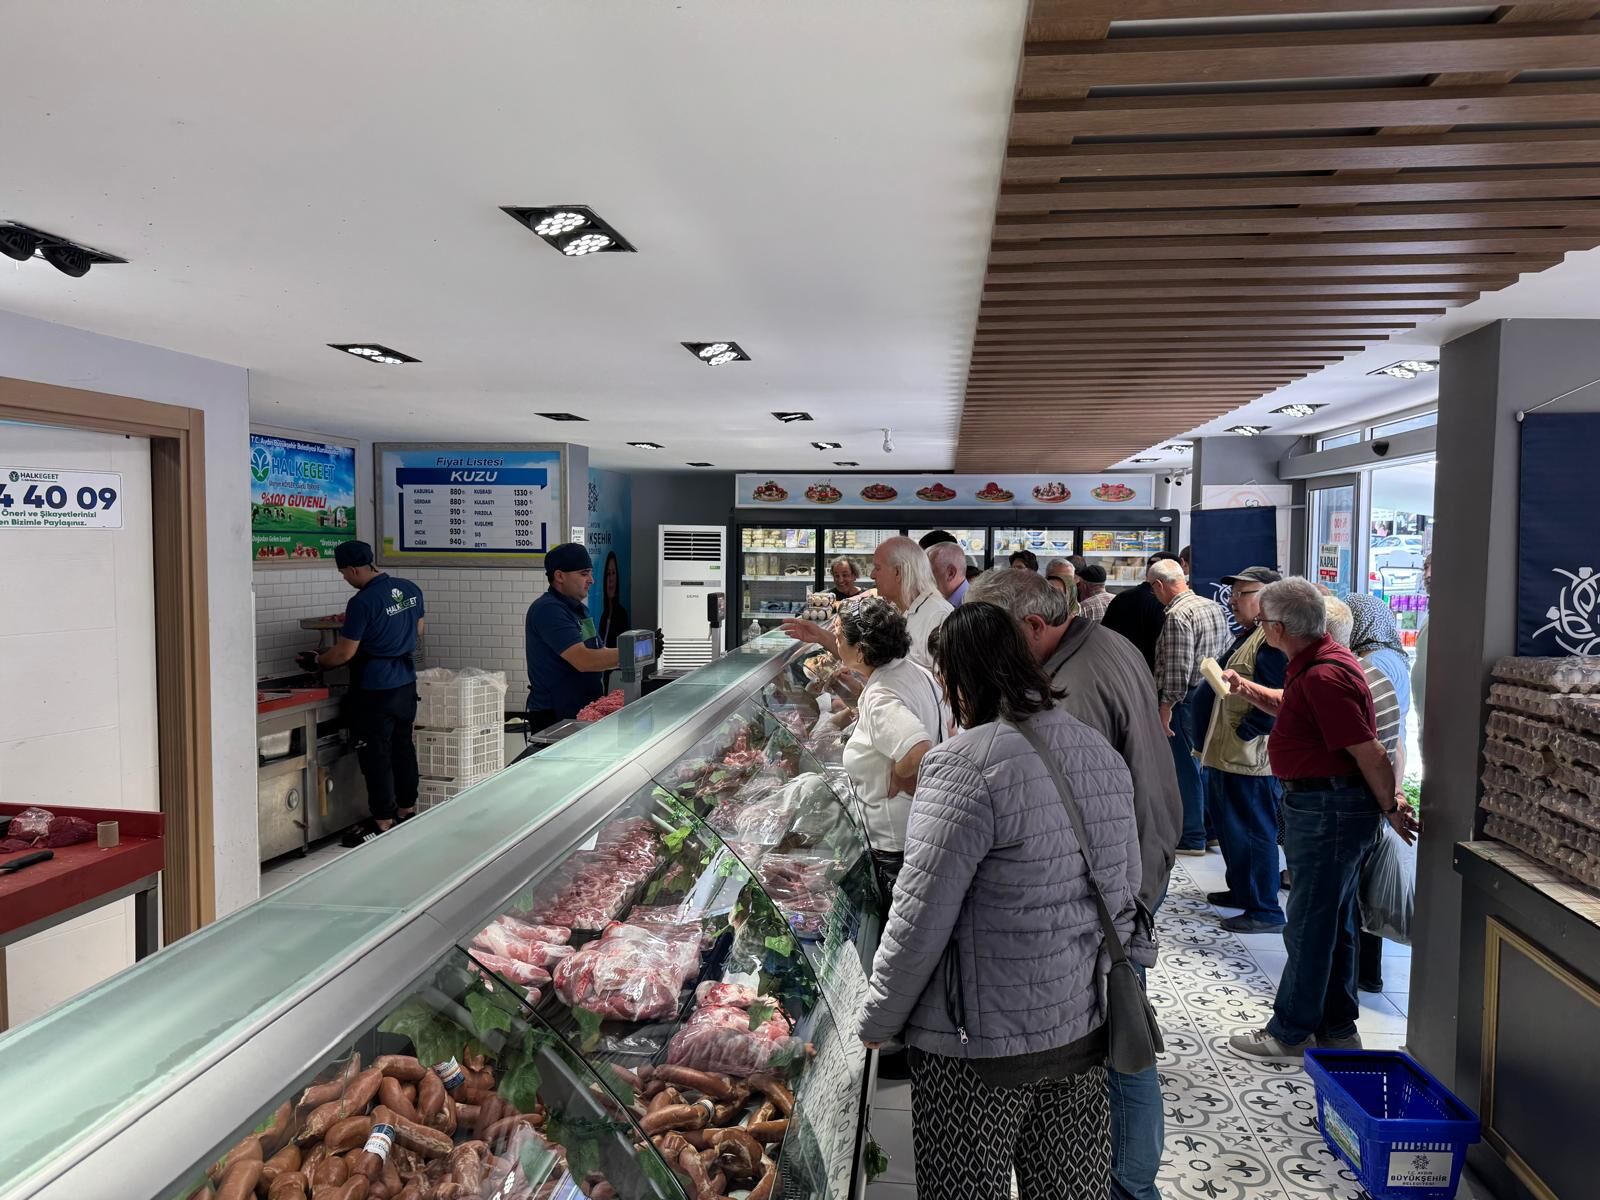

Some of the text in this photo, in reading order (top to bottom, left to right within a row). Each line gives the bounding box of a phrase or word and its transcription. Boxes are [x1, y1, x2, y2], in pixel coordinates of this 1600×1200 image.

[436, 456, 504, 467] Fiyat Listesi
[271, 457, 336, 482] HALKEGEET
[20, 472, 59, 480] HALKEGEET
[450, 471, 498, 482] KUZU
[450, 488, 462, 496] 880
[23, 484, 68, 509] 40
[76, 486, 117, 510] 09
[261, 491, 328, 509] %100 GÜVENLİ
[449, 498, 462, 506] 880
[1, 508, 26, 517] Öneri
[40, 510, 97, 518] Şikayetlerinizi
[449, 508, 461, 516] 910
[43, 519, 87, 527] Paylaşınız.
[514, 519, 530, 527] 1700
[515, 529, 529, 537] 1320
[515, 539, 530, 547] 1500
[1319, 555, 1338, 568] KAPALI
[1390, 1174, 1448, 1183] BÜYÜKŞEHİR
